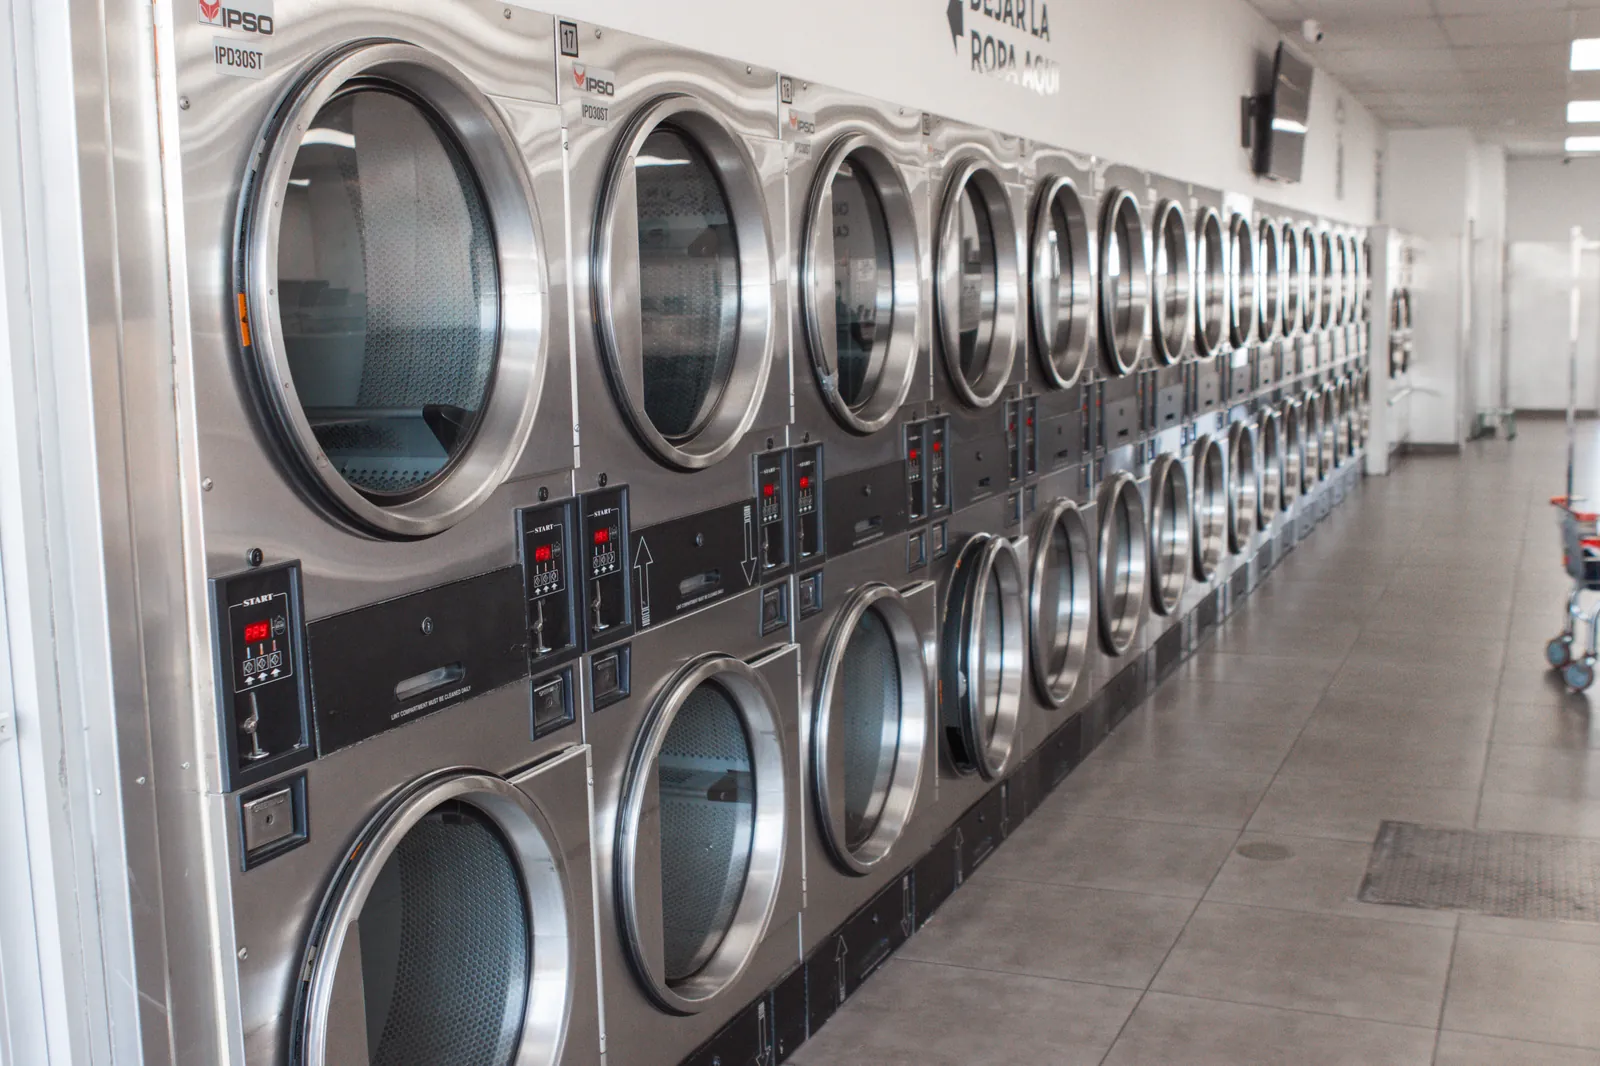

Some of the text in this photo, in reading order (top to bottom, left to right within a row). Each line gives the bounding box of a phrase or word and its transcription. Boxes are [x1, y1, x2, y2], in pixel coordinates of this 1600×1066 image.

[222, 8, 274, 35] IPSO
[564, 30, 574, 49] 17
[215, 46, 264, 70] IPD30ST
[970, 30, 1019, 84] ROPA
[586, 77, 615, 96] IPSO
[582, 104, 608, 121] IPD30ST
[593, 508, 612, 517] START
[534, 523, 554, 533] START
[243, 593, 273, 607] START
